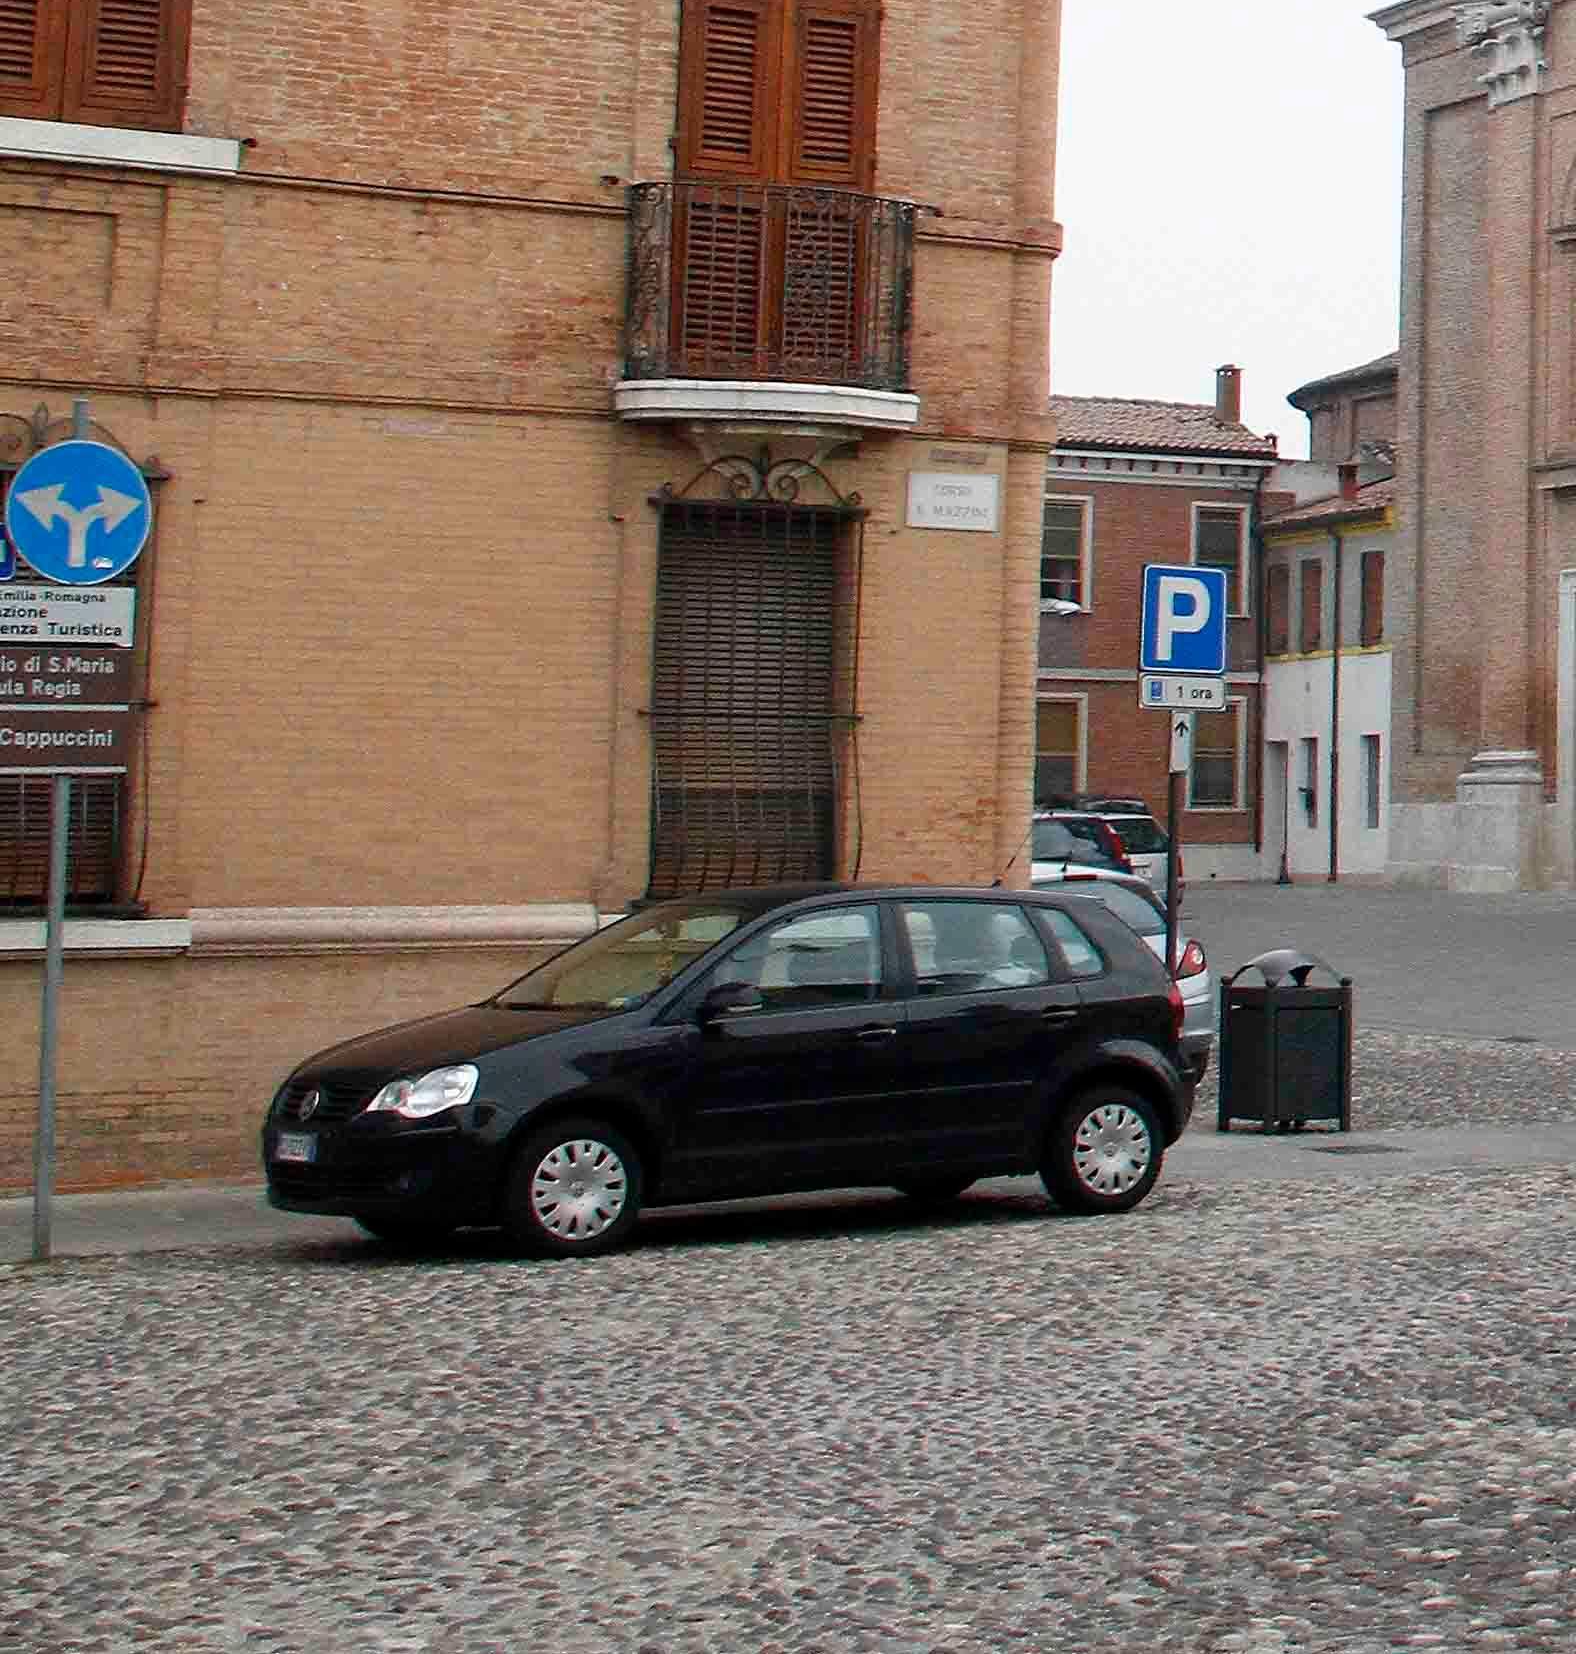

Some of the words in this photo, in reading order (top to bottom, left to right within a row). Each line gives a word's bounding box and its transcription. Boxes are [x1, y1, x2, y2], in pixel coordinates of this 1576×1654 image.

[47, 621, 123, 637] Turistica
[1155, 575, 1212, 662] P
[31, 677, 81, 699] Regia
[1191, 688, 1214, 699] ora
[0, 728, 113, 749] Cappuccini
